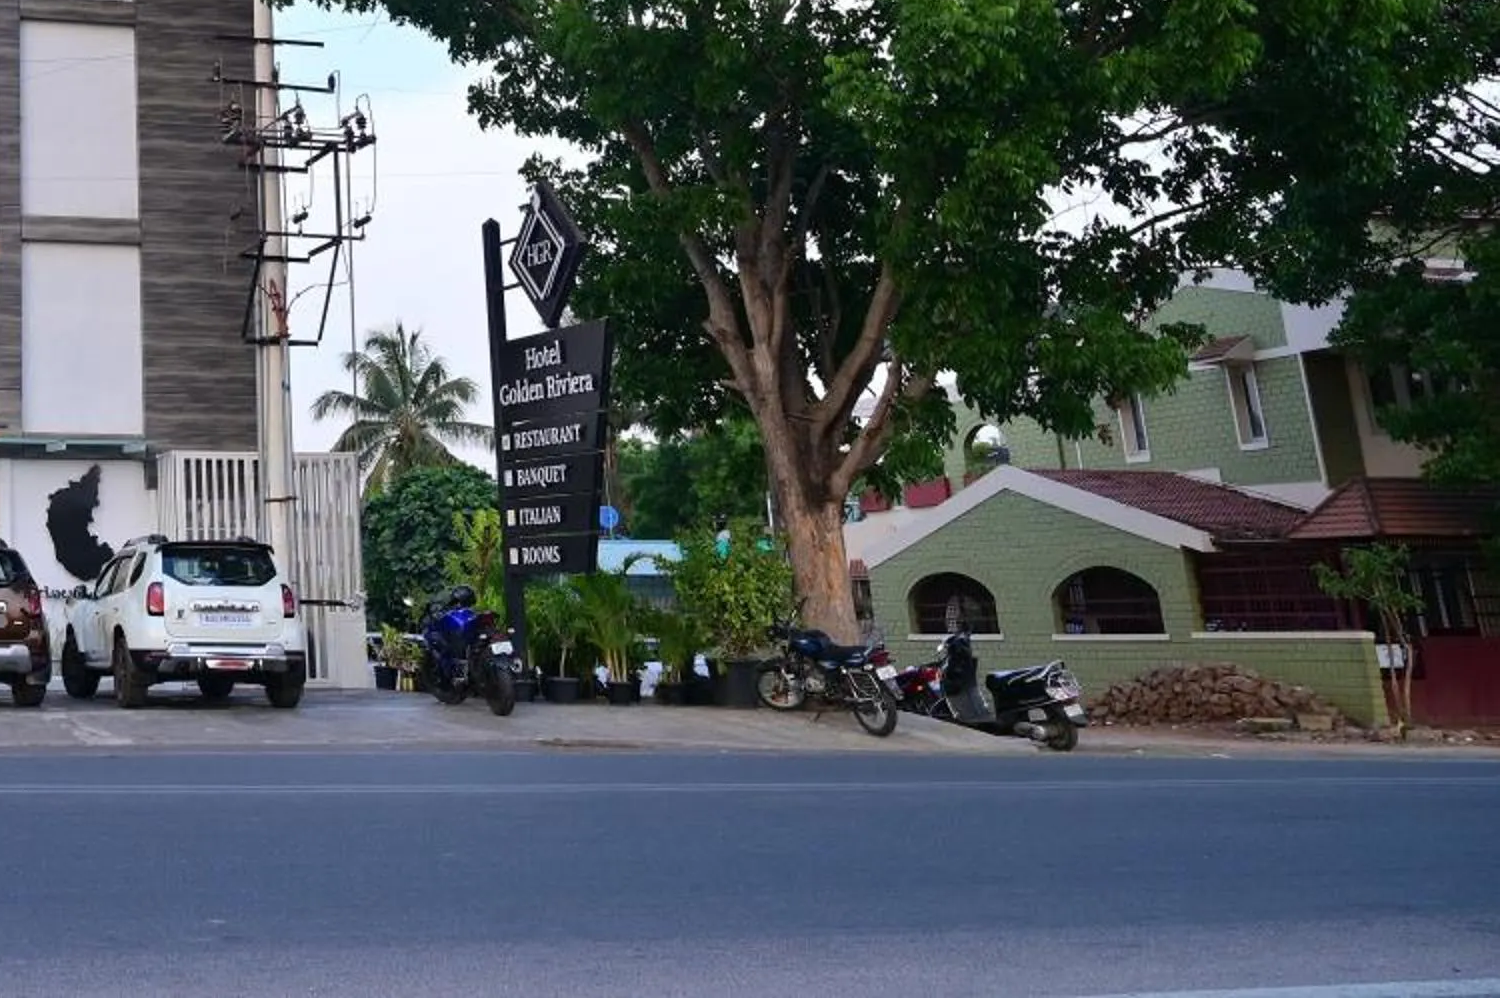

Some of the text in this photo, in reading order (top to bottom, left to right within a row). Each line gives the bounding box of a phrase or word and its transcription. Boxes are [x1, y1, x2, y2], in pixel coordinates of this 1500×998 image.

[526, 239, 553, 267] HGR
[524, 339, 562, 371] Hotel
[499, 371, 594, 406] Golden Riviera
[513, 423, 581, 449] RESTAURANT
[516, 463, 567, 488] BANQUET
[519, 505, 562, 526] ITALIAN
[521, 545, 562, 565] ROOMS
